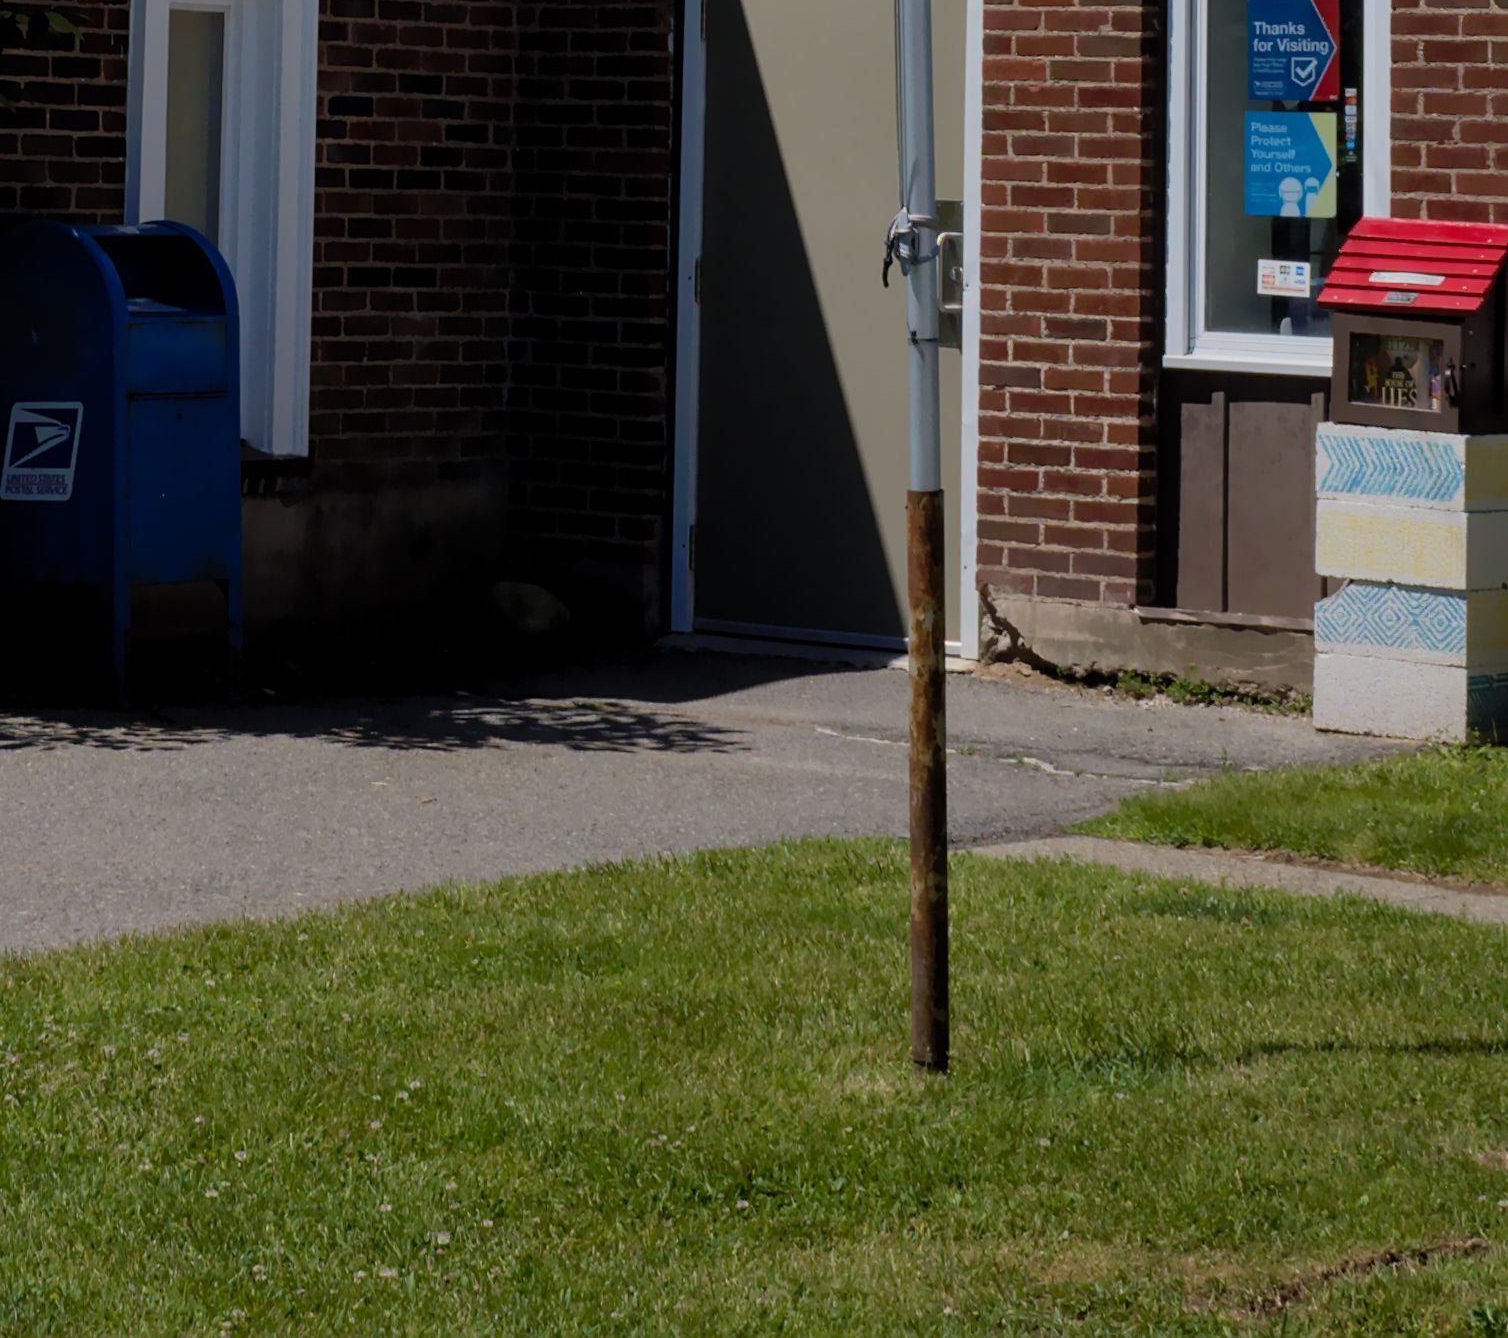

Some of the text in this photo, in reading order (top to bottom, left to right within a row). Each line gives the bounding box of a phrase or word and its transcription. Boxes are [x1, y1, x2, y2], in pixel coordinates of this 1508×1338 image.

[1253, 21, 1306, 35] Thanks
[1253, 38, 1329, 55] for Visiting
[1250, 122, 1288, 133] Please
[1250, 135, 1291, 146] Protect
[1250, 149, 1296, 159] Yourself
[1250, 162, 1312, 173] and Others
